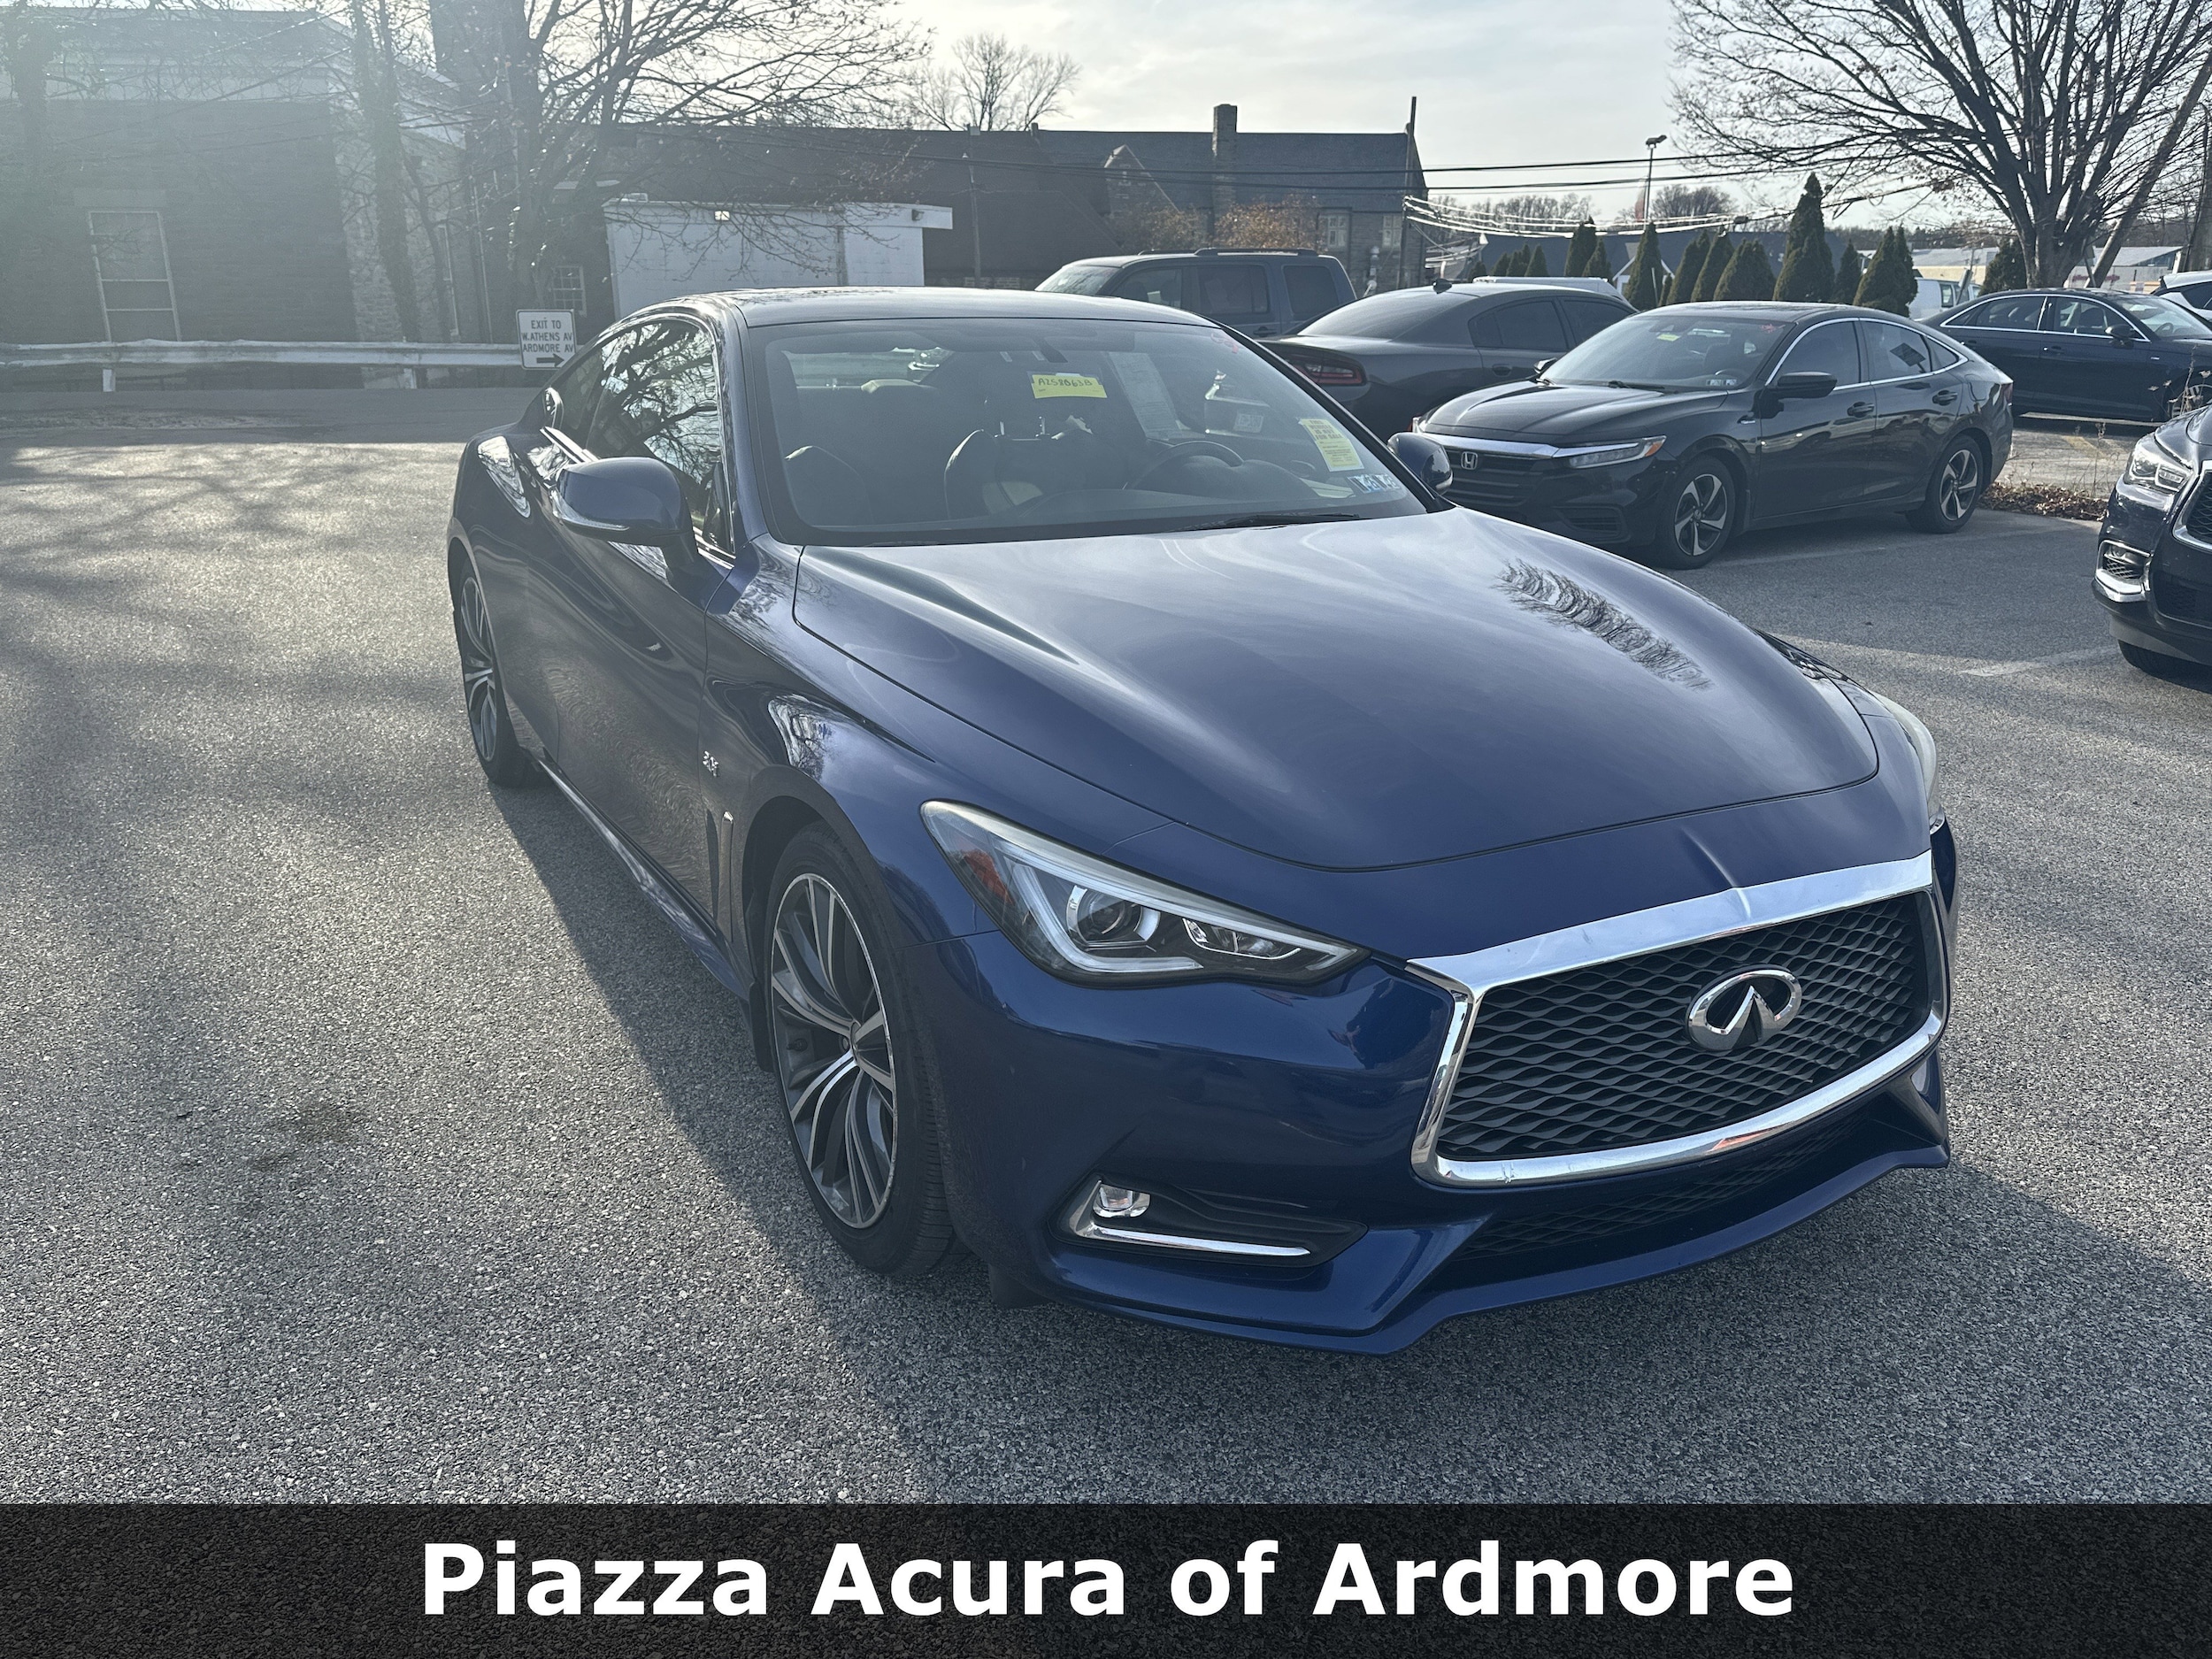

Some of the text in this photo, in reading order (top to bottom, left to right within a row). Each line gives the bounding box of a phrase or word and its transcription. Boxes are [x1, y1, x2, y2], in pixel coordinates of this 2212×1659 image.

[531, 319, 562, 329] EXIT TO
[563, 332, 572, 342] AV
[523, 343, 573, 353] ARDMORE AV
